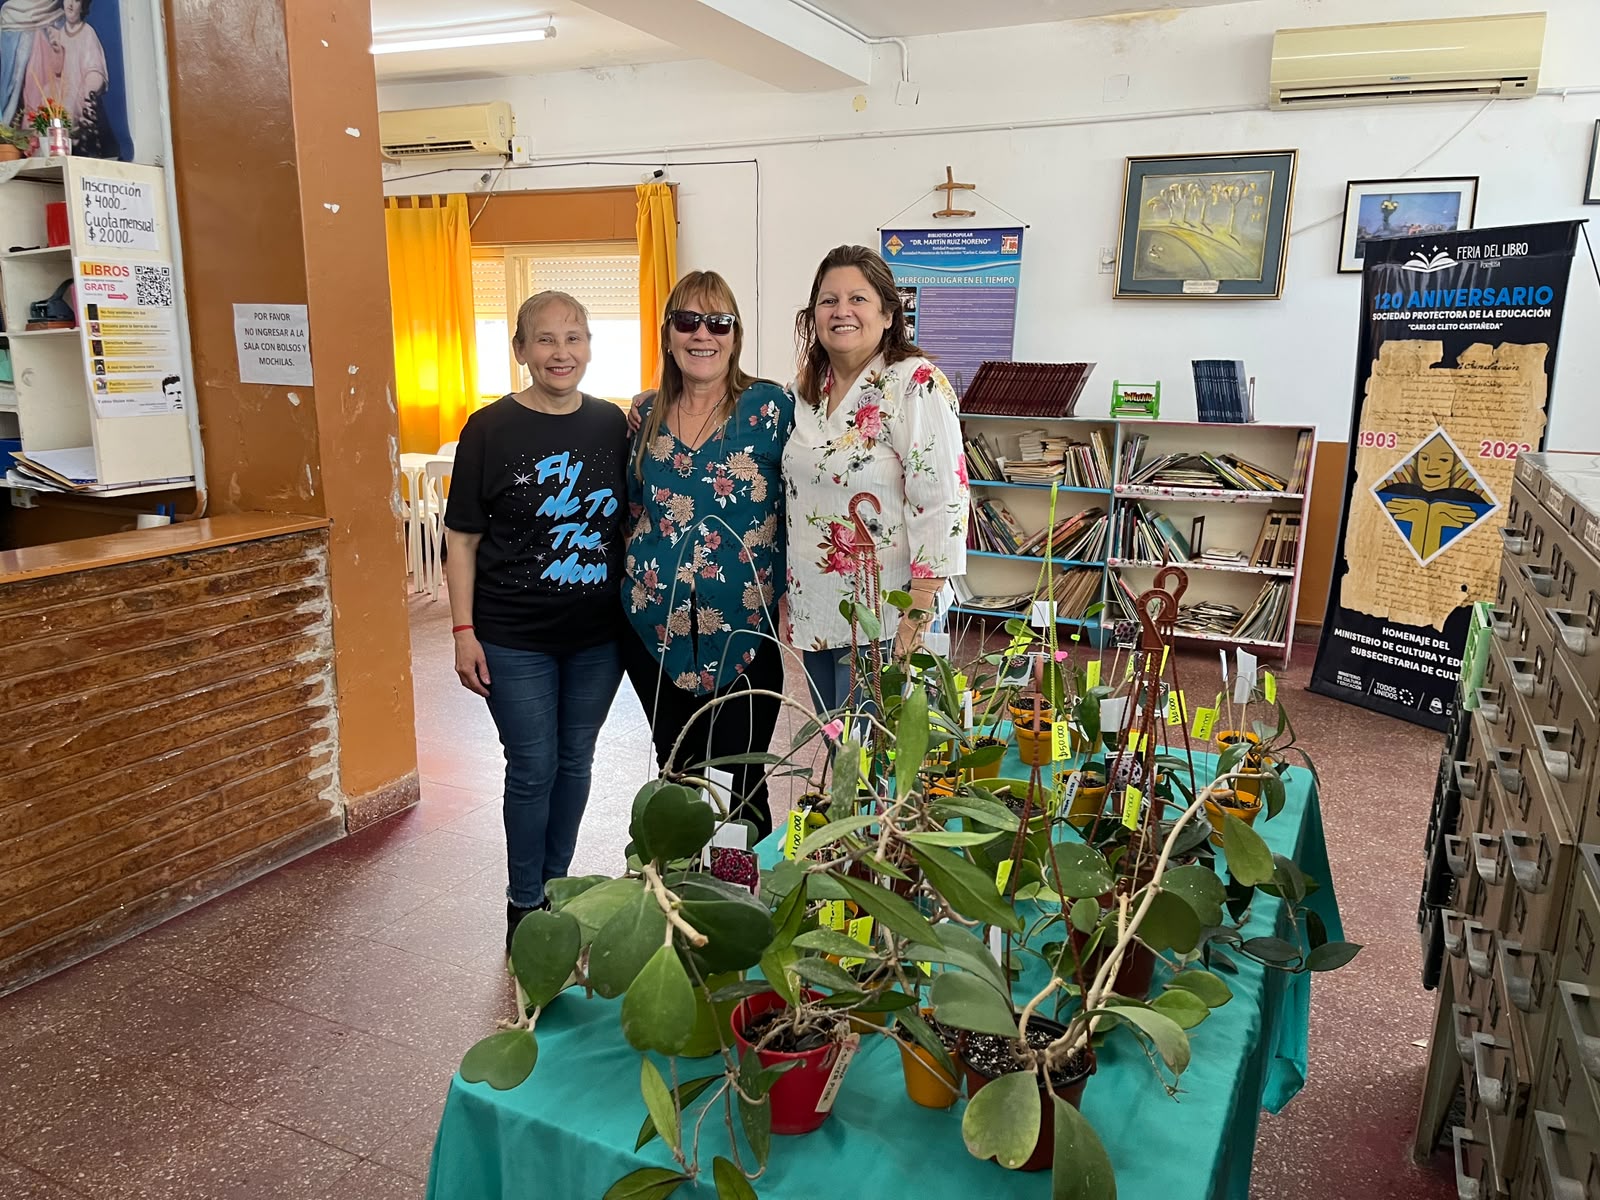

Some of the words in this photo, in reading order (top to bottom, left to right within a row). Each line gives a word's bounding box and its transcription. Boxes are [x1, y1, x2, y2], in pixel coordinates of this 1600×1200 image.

[82, 177, 141, 198] Inscripción
[85, 194, 91, 208] $
[85, 211, 118, 228] Cuota
[120, 218, 154, 232] mensual
[89, 226, 96, 241] $
[1457, 245, 1480, 259] FERIA
[1484, 244, 1500, 258] DEL
[1502, 242, 1528, 256] LIBRO
[84, 264, 130, 277] LIBROS
[84, 283, 116, 291] GRATIS
[1374, 292, 1403, 310] 120
[1407, 286, 1554, 308] ANIVERSARIO
[254, 312, 268, 320] POR
[269, 313, 291, 321] FAVOR
[1372, 311, 1411, 320] SOCIEDAD
[1412, 310, 1468, 319] PROTECTORA
[1469, 310, 1481, 318] DE
[1482, 309, 1494, 318] LA
[1495, 307, 1551, 318] EDUCACIÓN
[245, 328, 254, 336] NO
[255, 328, 289, 337] INGRESAR
[290, 329, 295, 337] A
[296, 329, 304, 337] LA
[244, 342, 260, 350] SALA
[261, 343, 276, 351] CON
[276, 343, 301, 352] BOLSOS
[302, 344, 306, 352] Y
[259, 357, 295, 366] MOCHILAS.
[1360, 431, 1397, 449] 1903
[535, 451, 583, 490] Fly
[536, 488, 581, 521] Me
[548, 522, 602, 550] The
[540, 552, 608, 586] Moon
[1334, 628, 1381, 647] MINISTERIO
[1382, 641, 1394, 651] DE
[1396, 645, 1438, 662] CULTURA
[1438, 654, 1446, 663] Y
[1382, 627, 1431, 646] HOMENAJE
[1432, 639, 1450, 651] DEL
[1350, 646, 1420, 671] SUBSECRETARIA
[1421, 665, 1434, 675] DE
[1374, 688, 1398, 700] UNIDOS
[1376, 682, 1396, 694] TODOS
